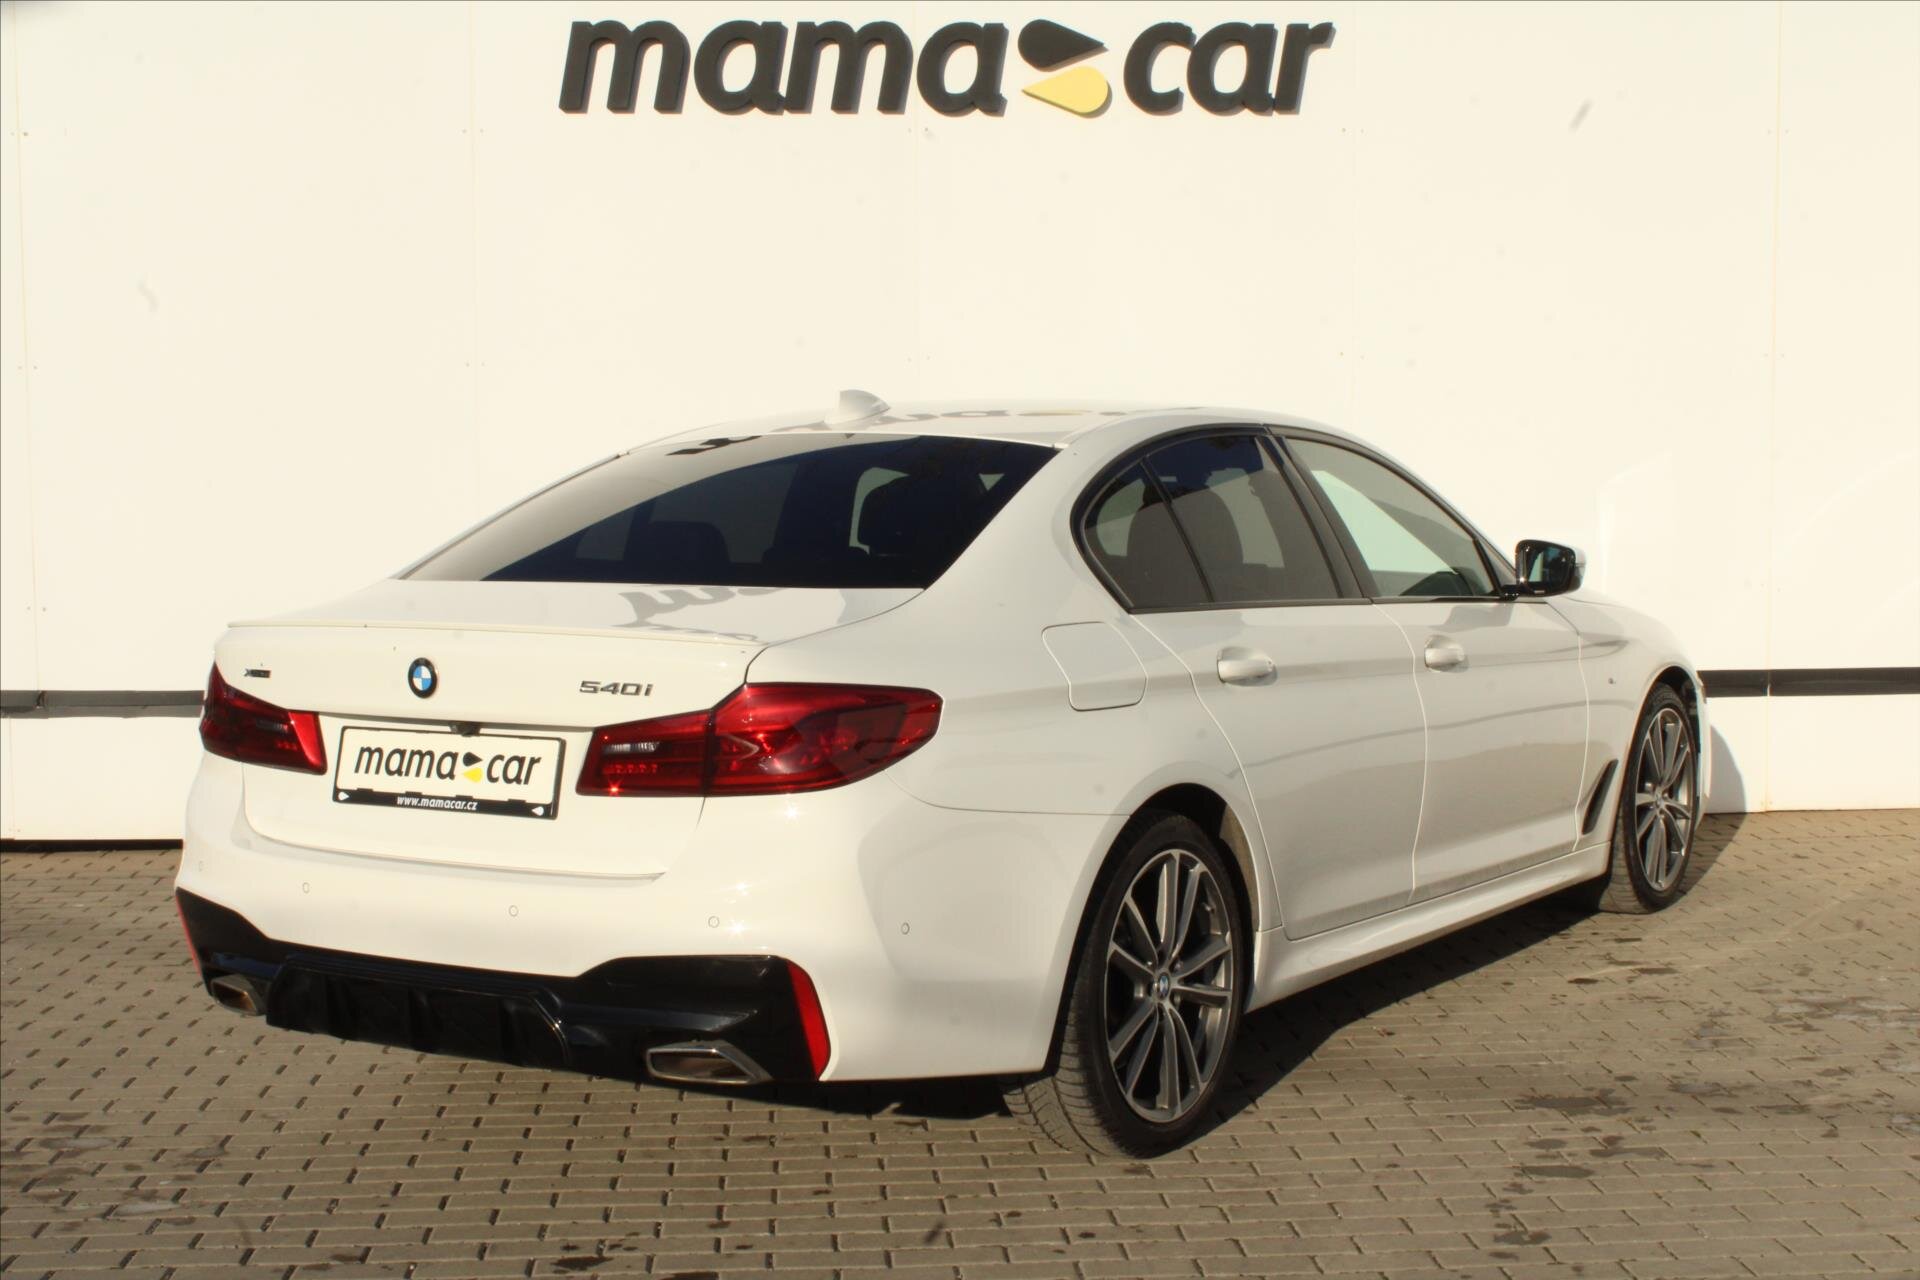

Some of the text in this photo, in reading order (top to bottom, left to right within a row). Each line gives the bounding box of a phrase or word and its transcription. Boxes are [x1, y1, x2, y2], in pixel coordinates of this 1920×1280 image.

[558, 19, 1335, 116] mama car
[579, 680, 653, 697] 540i
[354, 745, 541, 785] mama car
[396, 795, 478, 812] www.mamacar.cz
